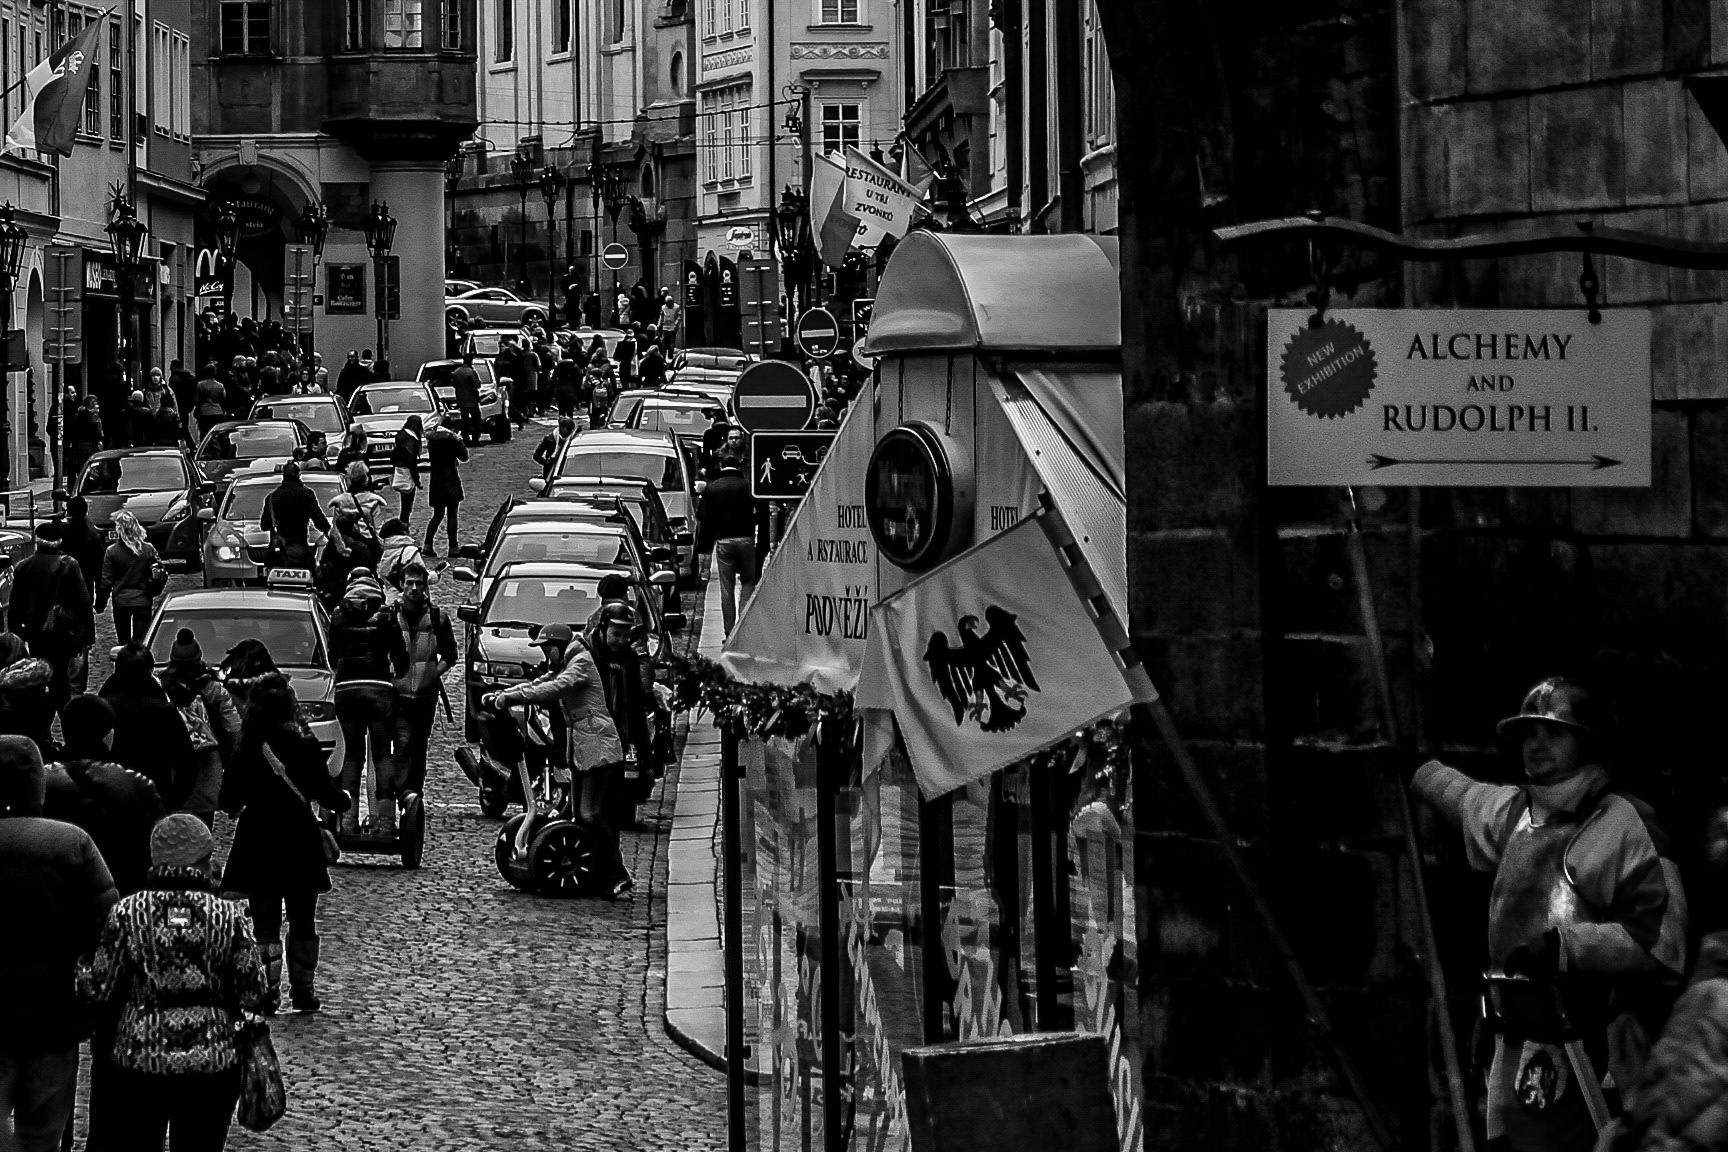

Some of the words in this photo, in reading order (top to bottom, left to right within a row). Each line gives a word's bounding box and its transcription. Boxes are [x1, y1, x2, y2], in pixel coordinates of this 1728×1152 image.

[846, 166, 910, 198] RESTAURANT
[866, 189, 874, 199] U
[1307, 341, 1334, 367] NEW
[1406, 332, 1573, 361] ALCHEMY
[1297, 344, 1364, 394] EXHIBITION
[1466, 374, 1515, 393] AND
[1382, 404, 1551, 433] RUDOLPH
[1566, 404, 1599, 432] II.
[837, 505, 866, 529] HOTEL
[807, 538, 813, 561] A
[274, 570, 307, 579] TAXI
